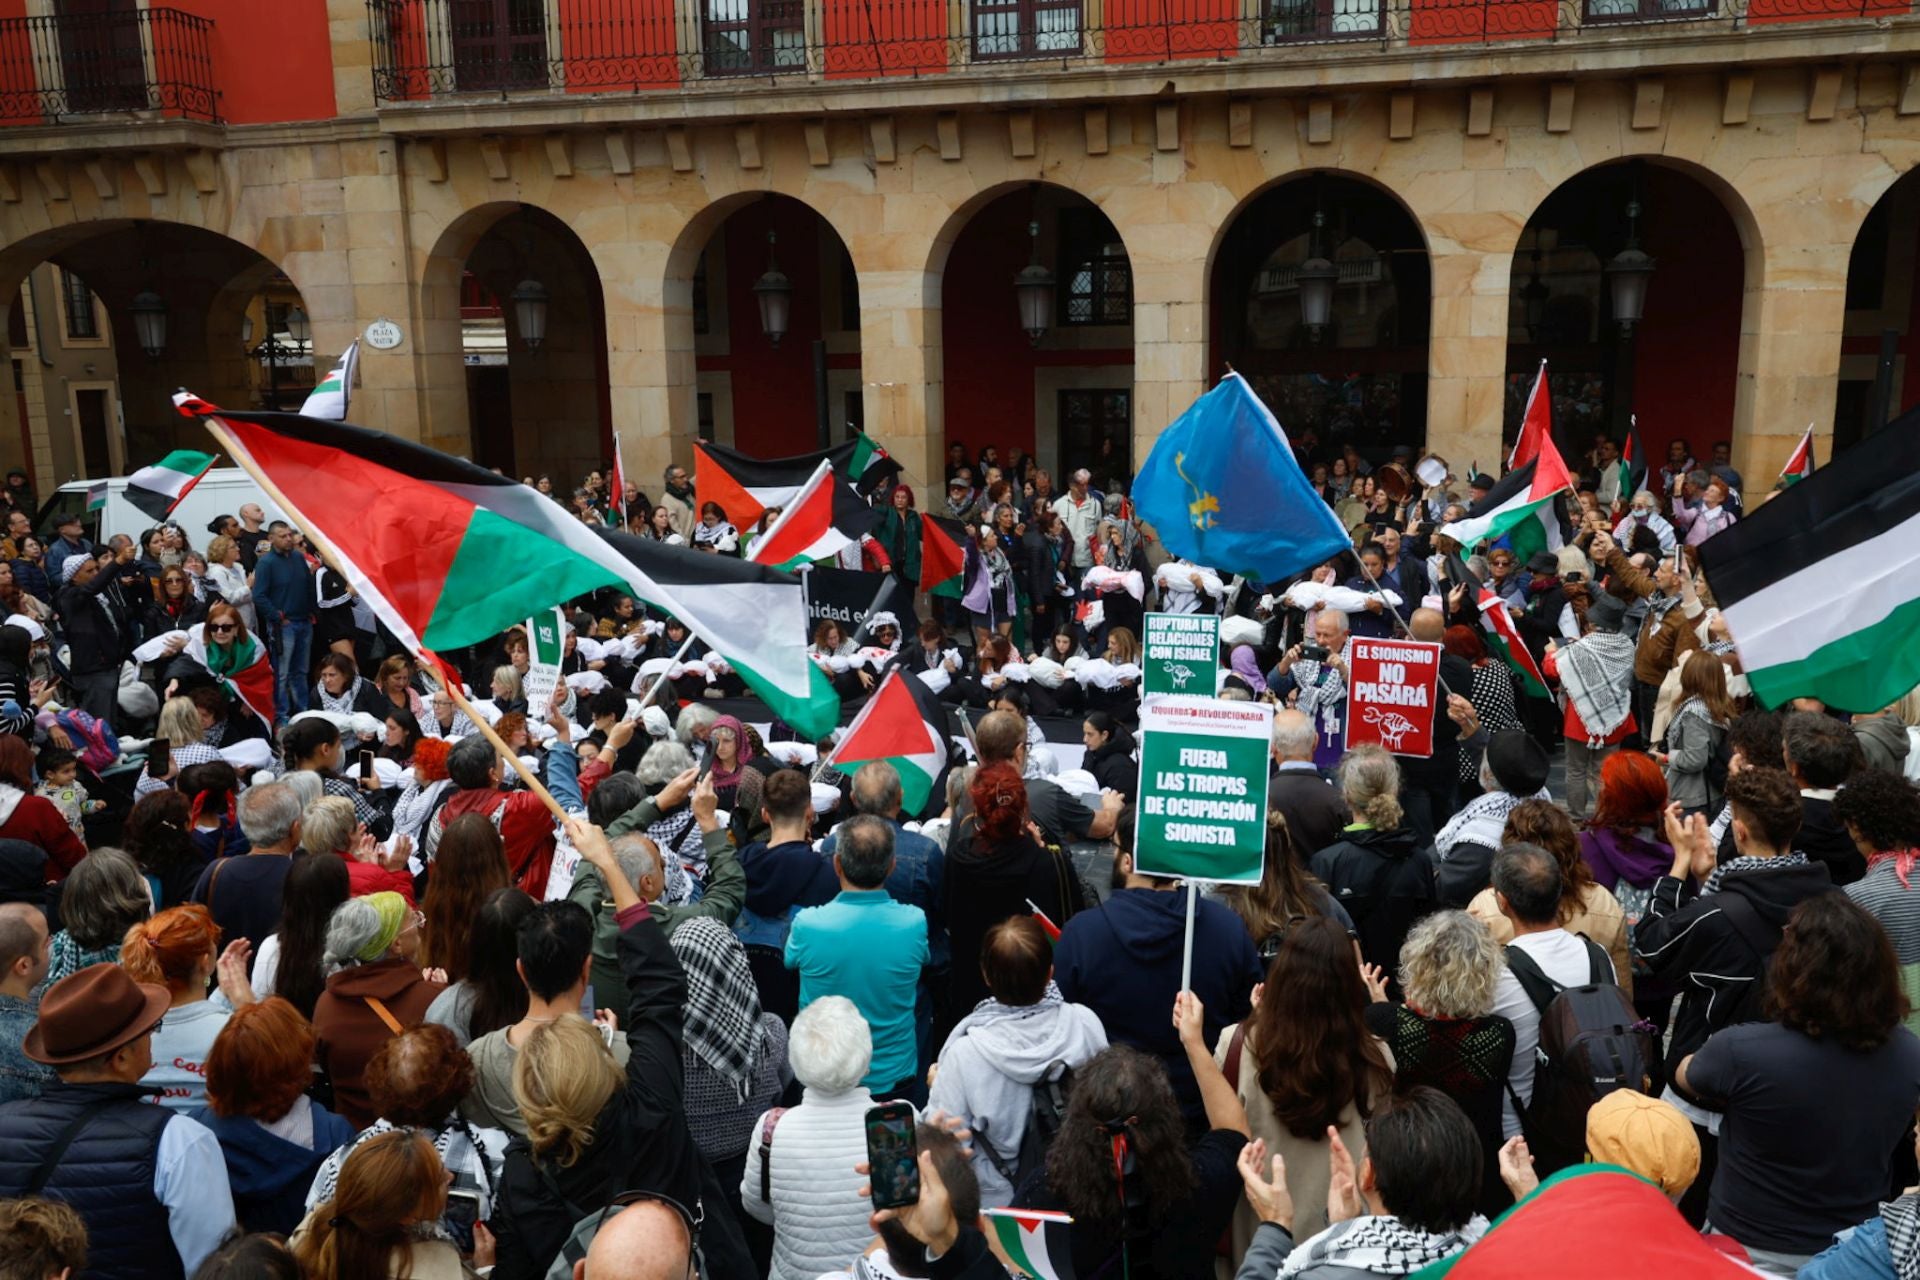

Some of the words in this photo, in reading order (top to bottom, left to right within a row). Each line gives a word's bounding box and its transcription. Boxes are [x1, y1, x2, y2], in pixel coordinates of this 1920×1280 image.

[1148, 617, 1200, 632] RUPTURA
[1201, 619, 1216, 633] DE
[1148, 631, 1215, 648] RELACIONES
[1149, 646, 1173, 660] CON
[1174, 647, 1212, 662] ISRAEL
[1356, 645, 1369, 659] EL
[1370, 646, 1434, 665] SIONISMO
[1379, 662, 1406, 685] NO
[1354, 681, 1428, 708] PASARÁ
[1151, 705, 1188, 717] IZQUIERDA
[1198, 709, 1264, 722] REVOLUCIONARIA
[1179, 748, 1228, 769] FUERA
[1156, 771, 1185, 791] LAS
[1186, 773, 1248, 796] TROPAS
[1144, 796, 1165, 815] DE
[1166, 797, 1257, 822] OCUPACIÓN
[1164, 822, 1236, 846] SIONISTA
